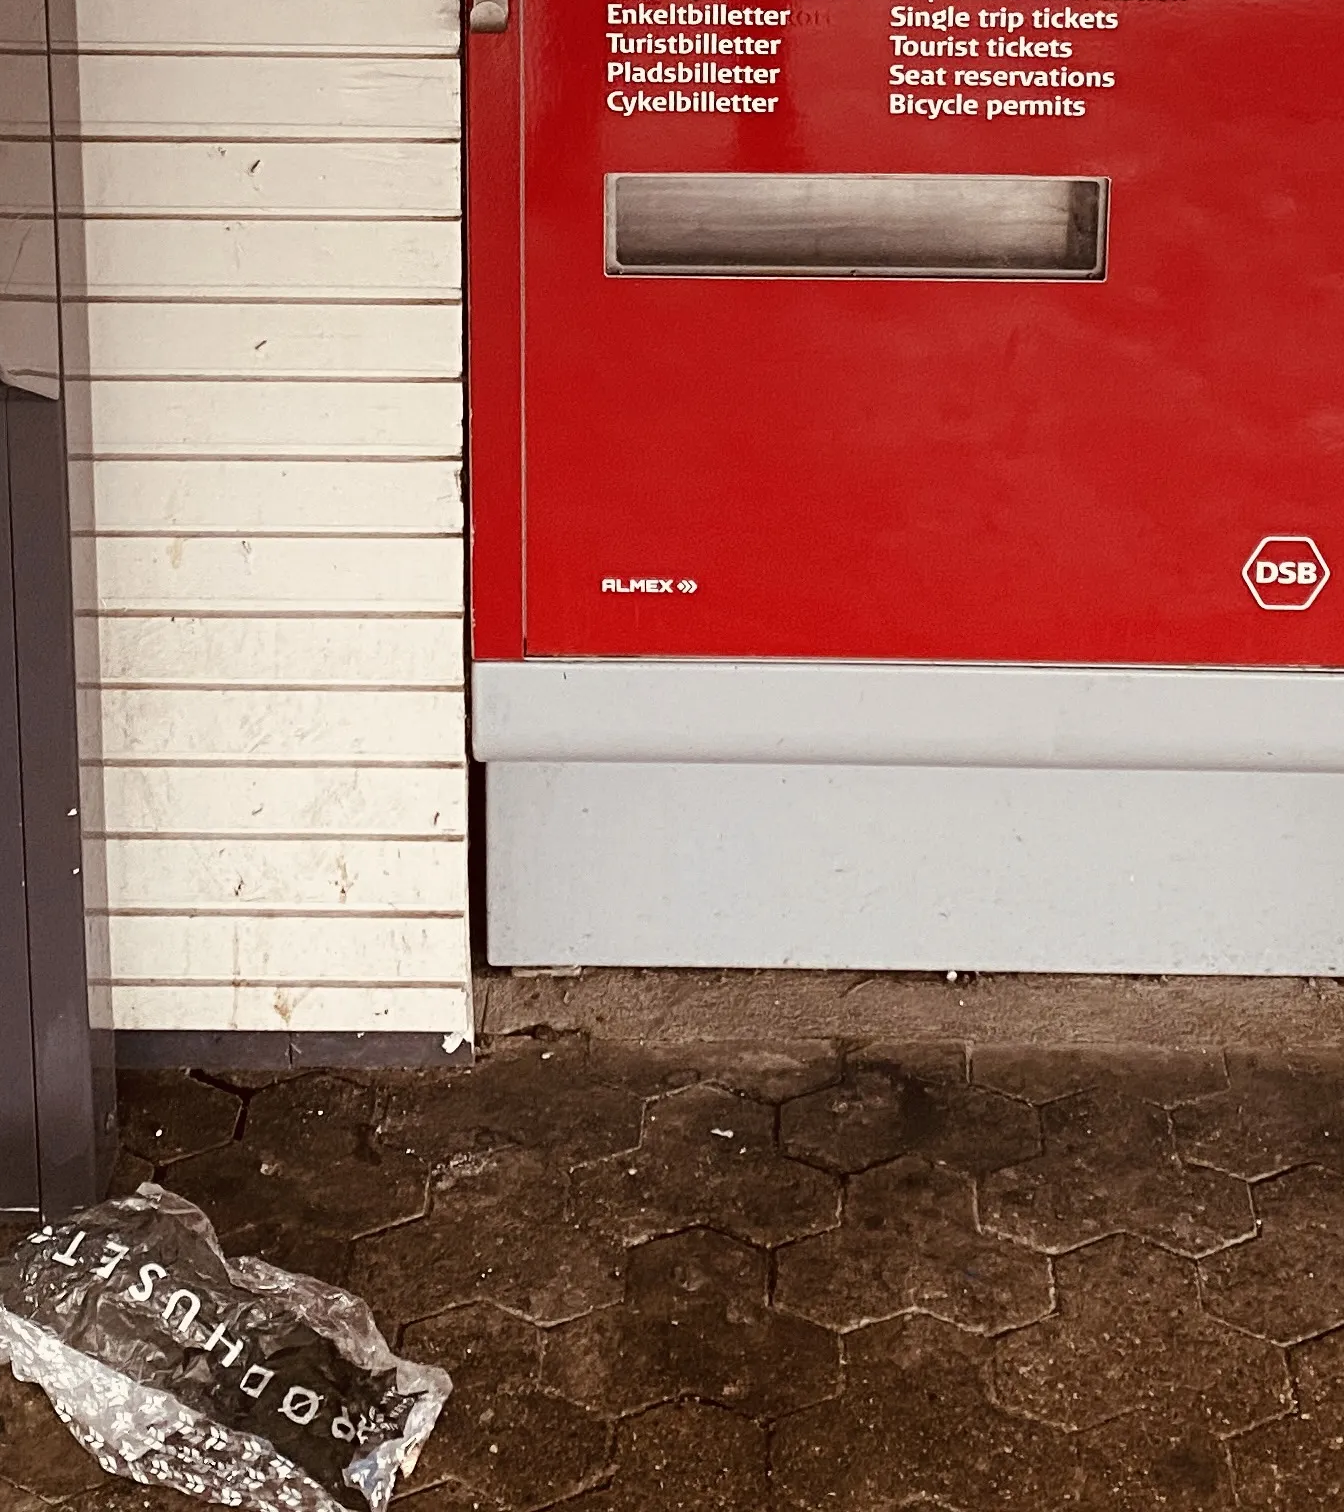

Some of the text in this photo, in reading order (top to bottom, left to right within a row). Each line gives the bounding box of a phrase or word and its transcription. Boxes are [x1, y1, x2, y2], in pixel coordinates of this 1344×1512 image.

[607, 3, 790, 26] Enkeltbilletter
[890, 6, 1119, 32] Single trip tickets
[606, 33, 781, 55] Turistbilletter
[889, 35, 1073, 58] Tourist tickets
[607, 62, 780, 84] Pladsbilletter
[889, 64, 1115, 88] Seat reservations
[607, 91, 778, 116] Cykelbilletter
[889, 93, 1086, 120] Bicycle permits
[1256, 561, 1317, 585] DSB
[601, 578, 674, 593] ALMEX
